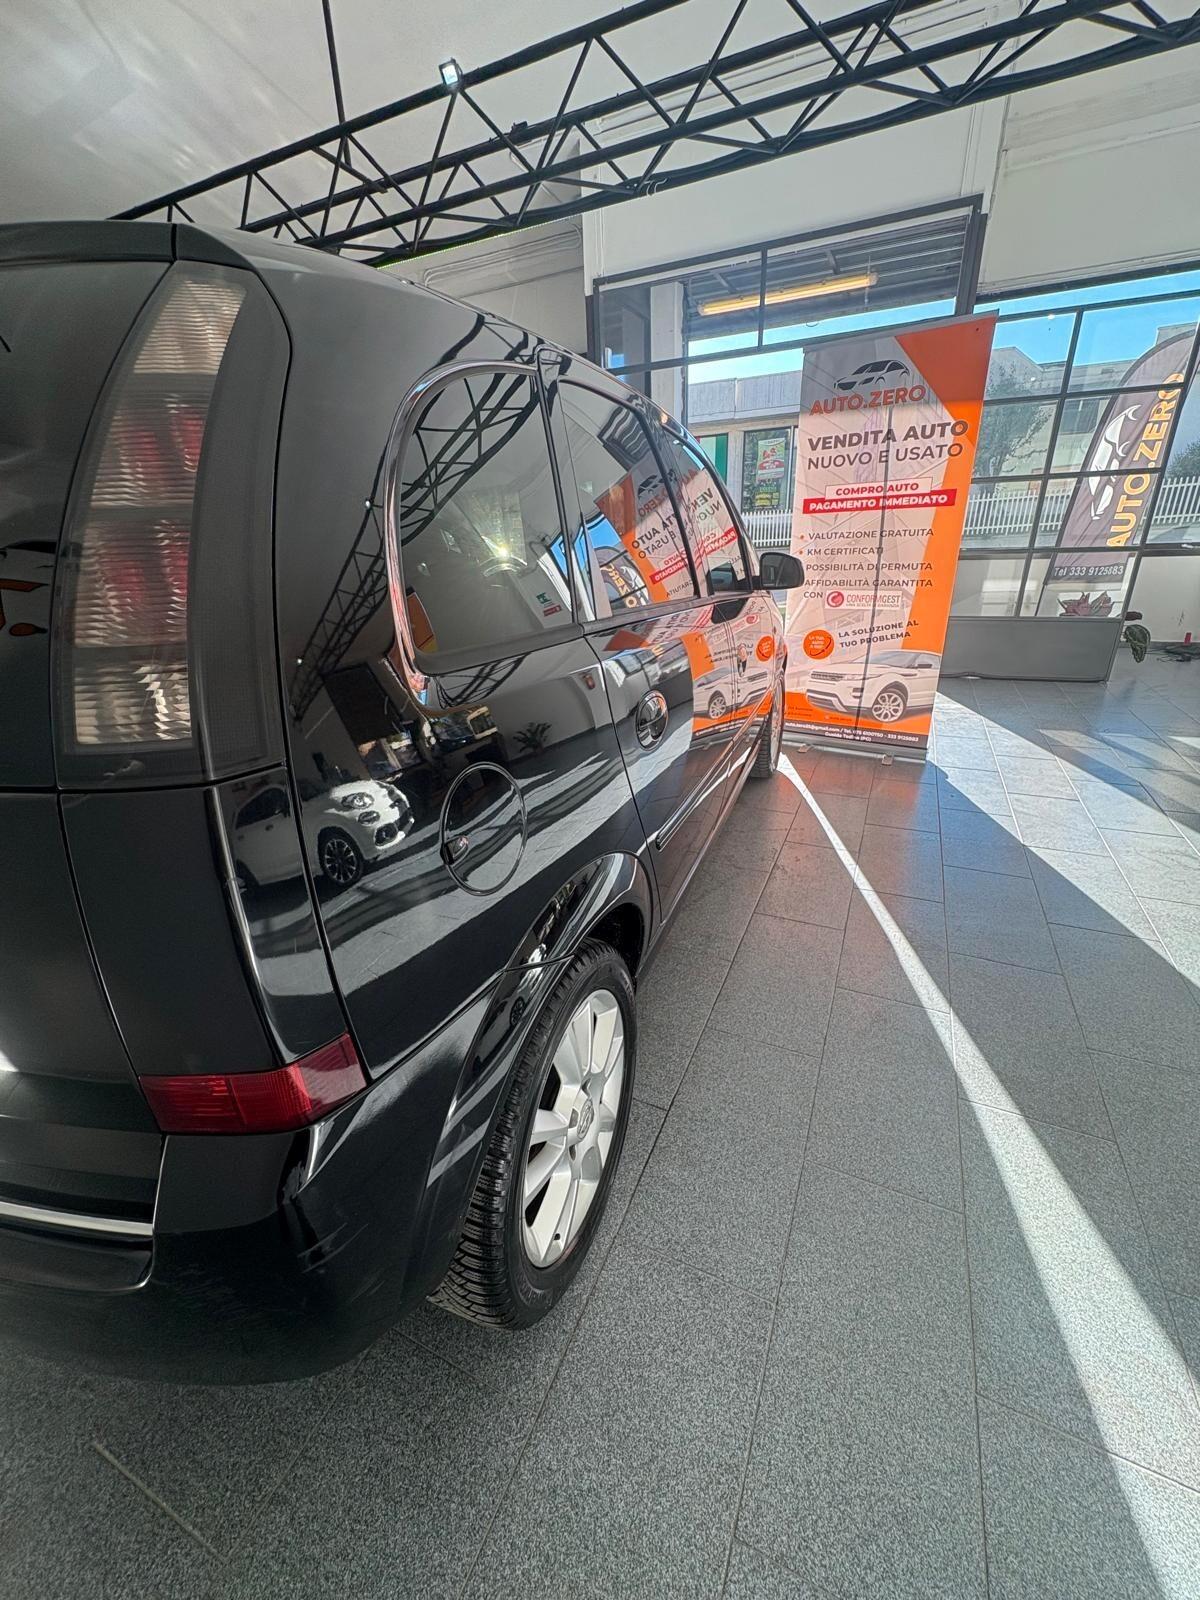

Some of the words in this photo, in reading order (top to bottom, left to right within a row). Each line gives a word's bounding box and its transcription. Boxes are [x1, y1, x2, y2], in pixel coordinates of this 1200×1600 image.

[809, 384, 927, 416] AUTO.ZERO
[808, 427, 897, 451] VENDITA
[902, 420, 969, 442] AUTO
[808, 451, 872, 470] NUOVO
[878, 450, 890, 464] E
[895, 442, 964, 462] USATO
[836, 485, 884, 496] COMPRO
[888, 482, 919, 492] AUTO
[808, 500, 876, 511] PAGAMENTO
[879, 494, 948, 508] IMMEDIATO
[808, 530, 878, 541] VALUTAZIONE
[880, 528, 934, 538] GRATUITA
[807, 548, 821, 556] KM
[824, 547, 884, 556] CERTIFICATI
[806, 561, 864, 572] POSSIBILITÀ
[881, 562, 932, 571] PERMUTA
[1054, 567, 1068, 576] Tel
[1069, 566, 1086, 576] 333
[804, 577, 870, 588] AFFIDABILITÀ
[872, 580, 932, 588] GARANTITA
[804, 591, 824, 599] CON
[852, 622, 904, 636] SOLUZIONE
[840, 640, 858, 648] TUO
[860, 632, 911, 644] PROBLEMA
